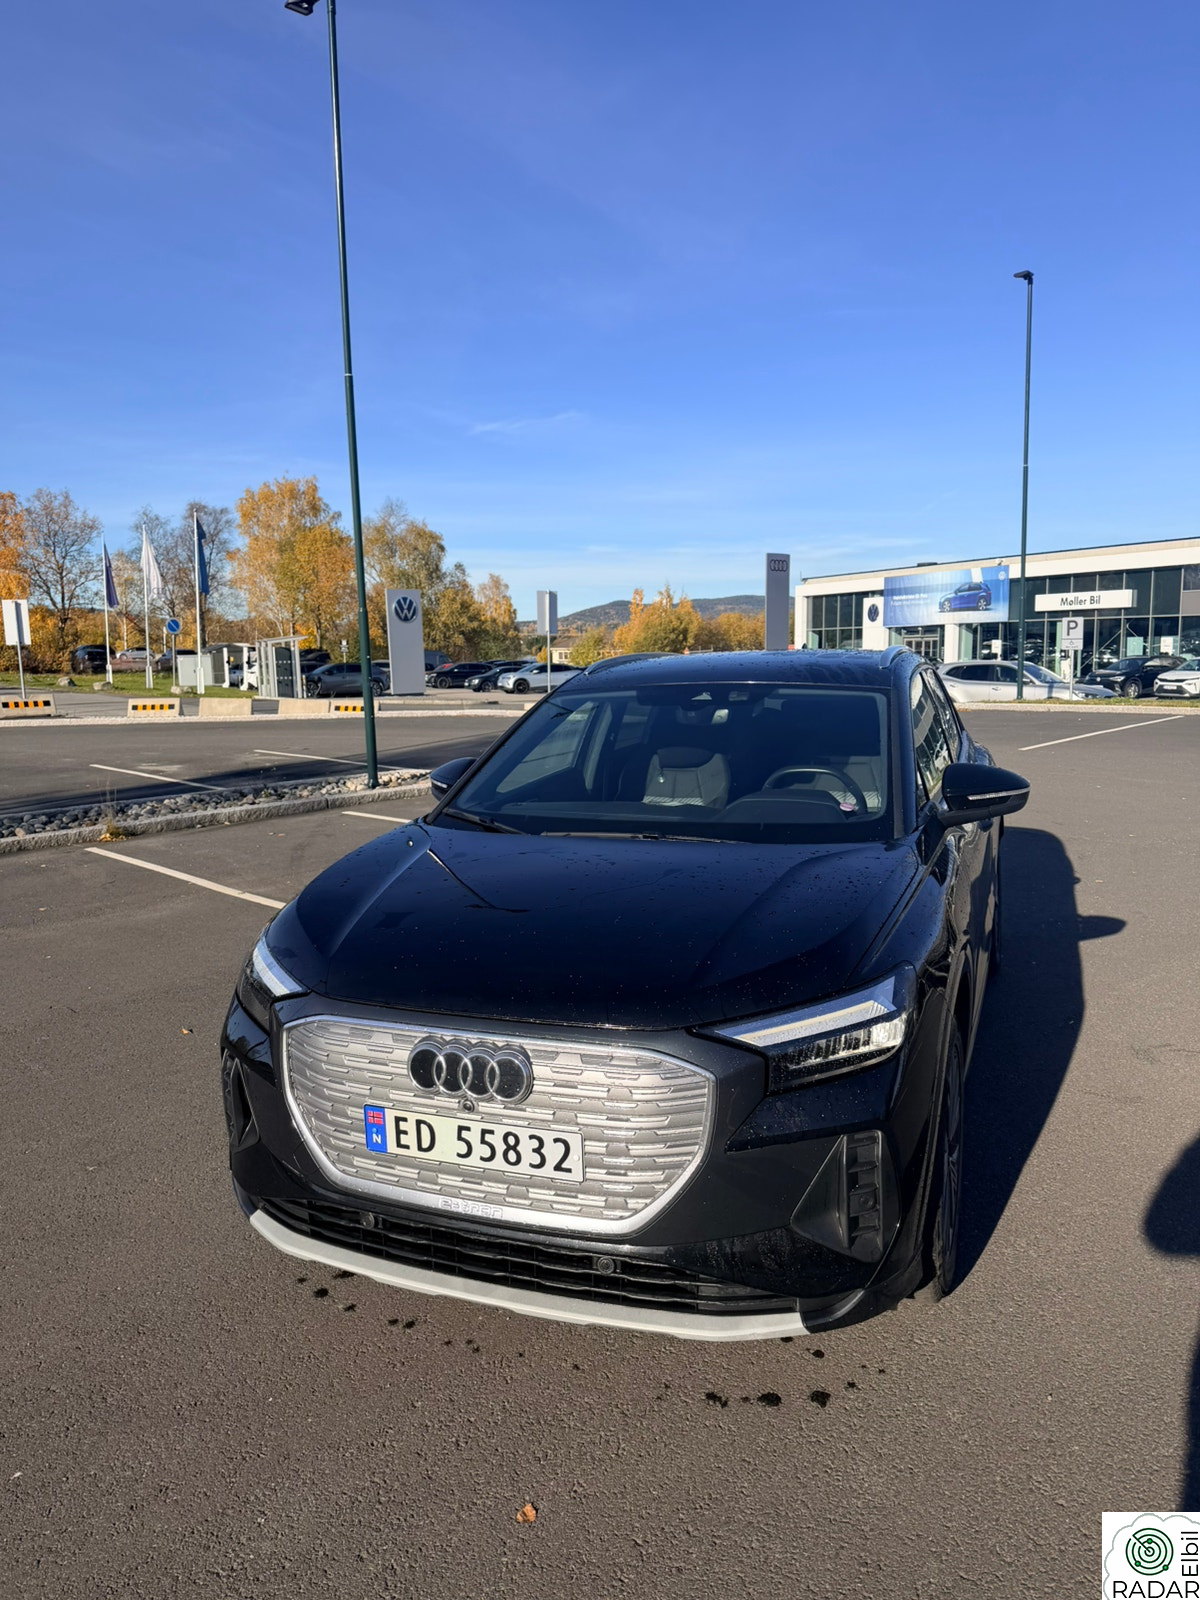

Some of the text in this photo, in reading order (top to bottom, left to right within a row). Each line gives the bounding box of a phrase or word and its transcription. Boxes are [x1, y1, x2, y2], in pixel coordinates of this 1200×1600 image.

[1060, 595, 1101, 606] Møller Bil
[1067, 620, 1078, 636] P
[372, 1133, 382, 1144] N
[394, 1116, 573, 1173] ED 55832
